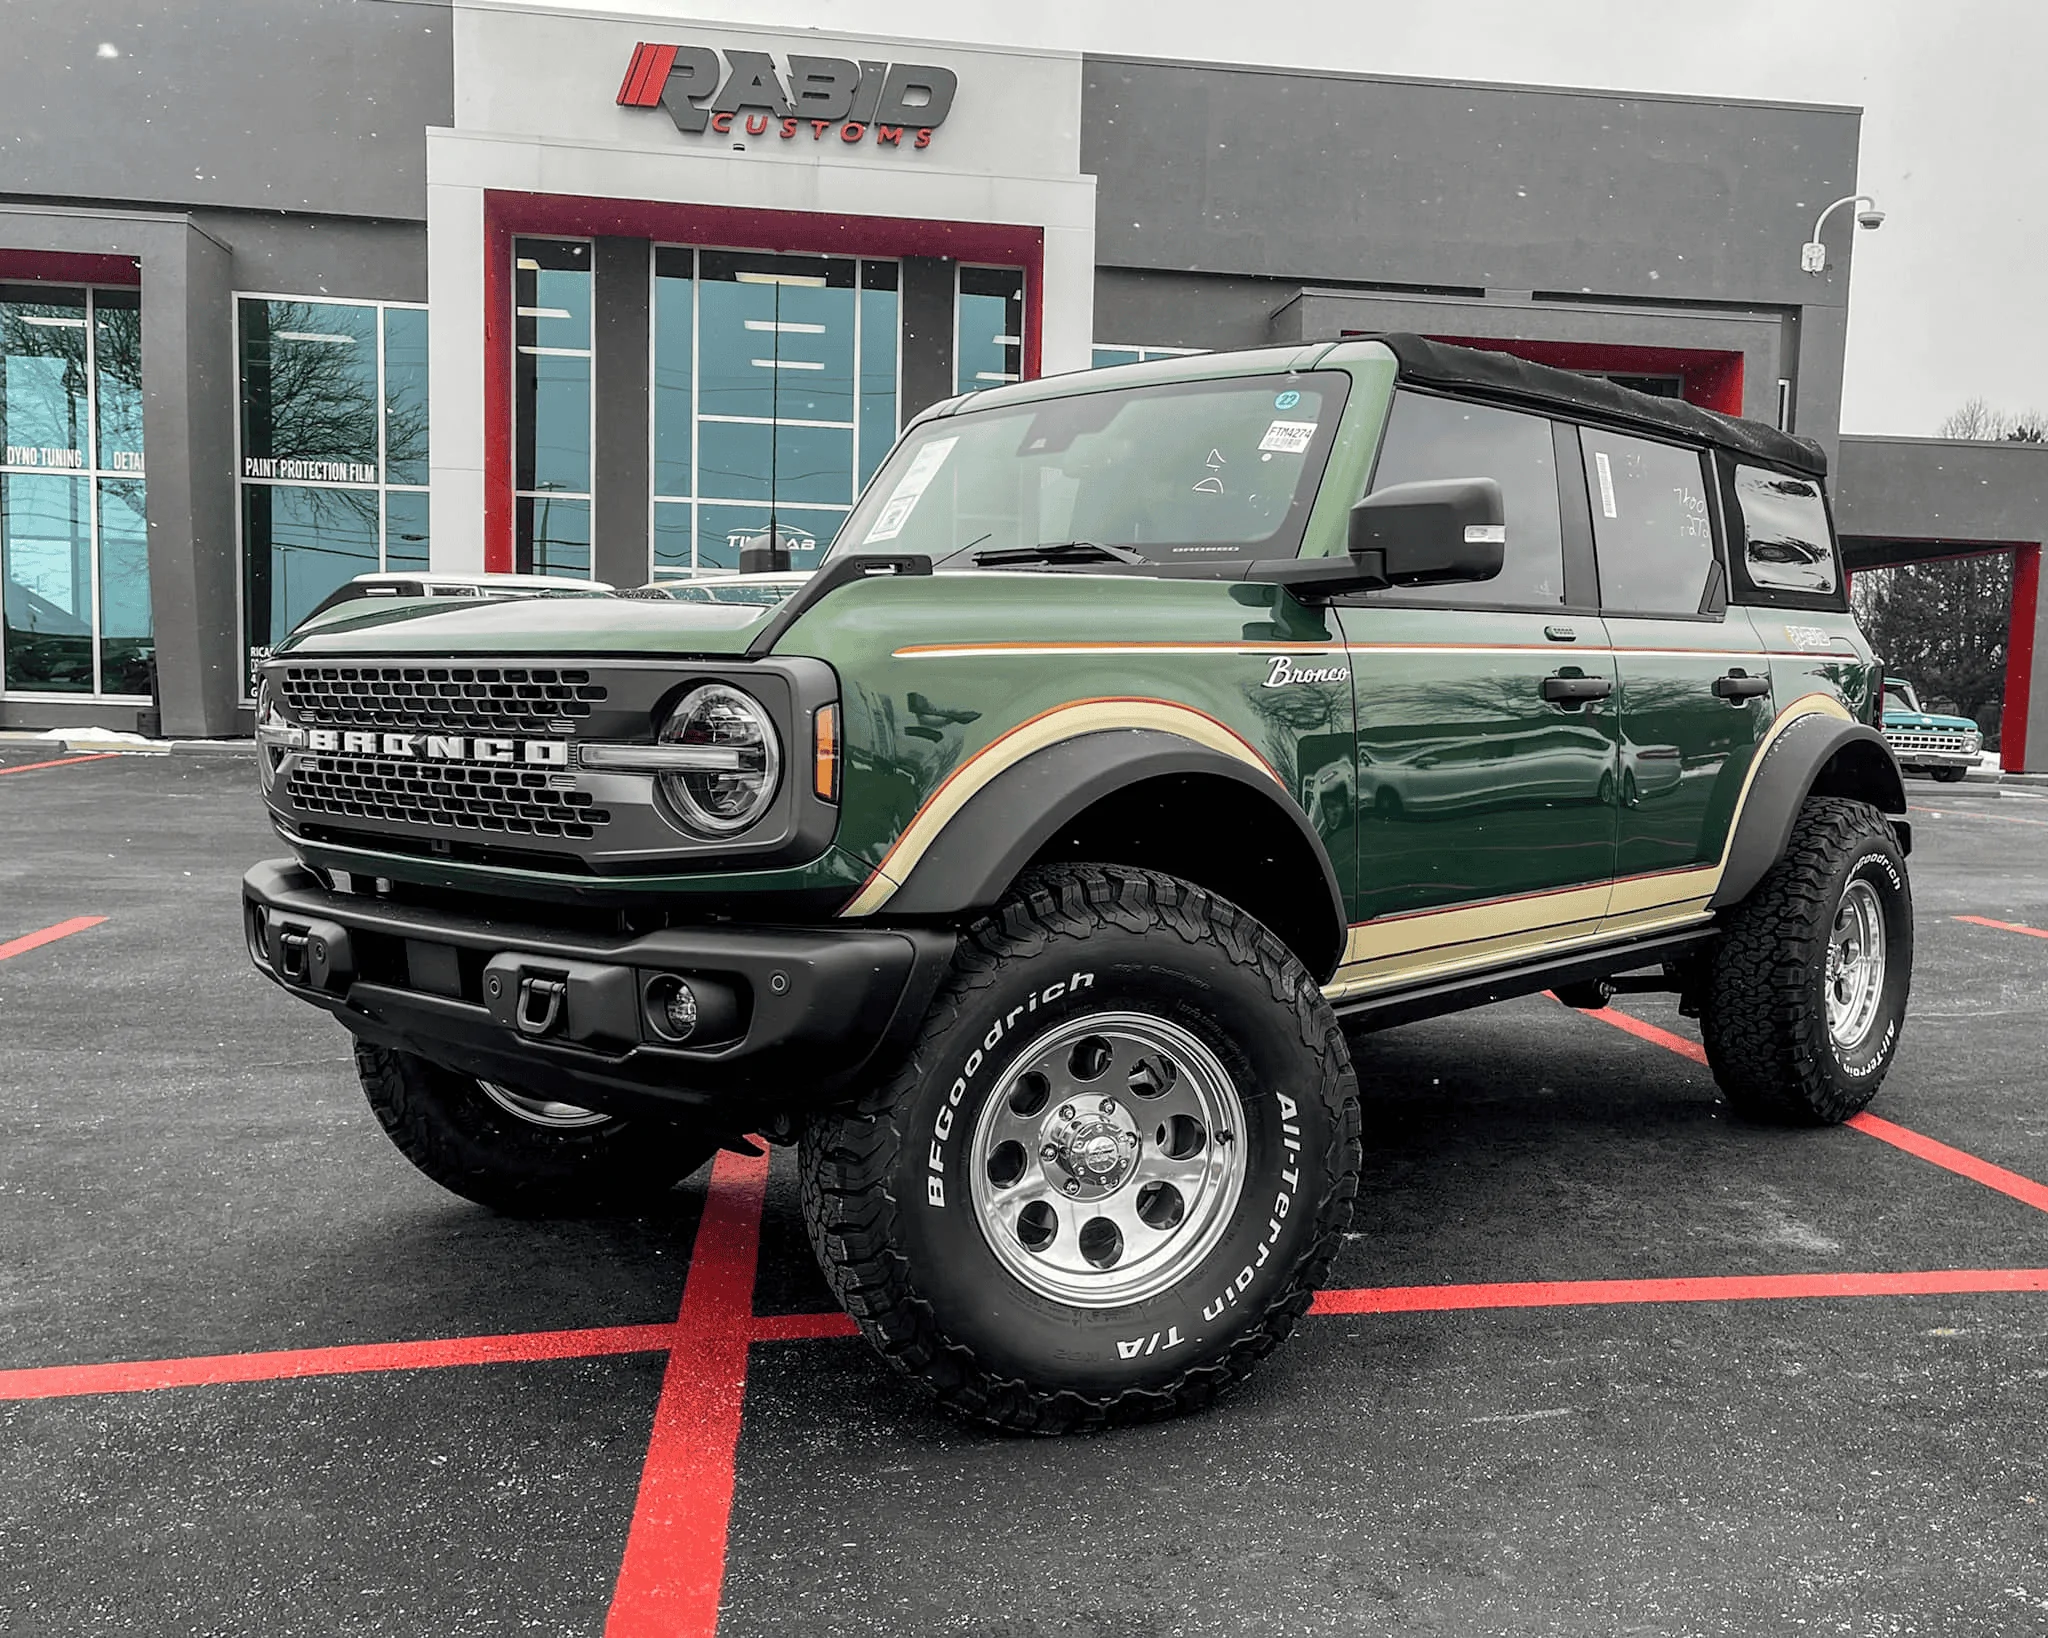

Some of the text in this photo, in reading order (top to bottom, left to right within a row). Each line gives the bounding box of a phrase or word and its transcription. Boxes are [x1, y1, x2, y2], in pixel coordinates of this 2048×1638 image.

[616, 41, 957, 132] RABID
[711, 112, 932, 148] CUSTOMS
[6, 446, 82, 468] DYNO TUNING
[245, 457, 375, 483] PAINT PROTECTION FILM
[1261, 655, 1351, 688] Bronco
[308, 729, 568, 765] BRONCO
[927, 972, 1095, 1207] BFGoodrich
[1202, 1090, 1301, 1322] All-Terrain
[1116, 1326, 1185, 1360] T/A
